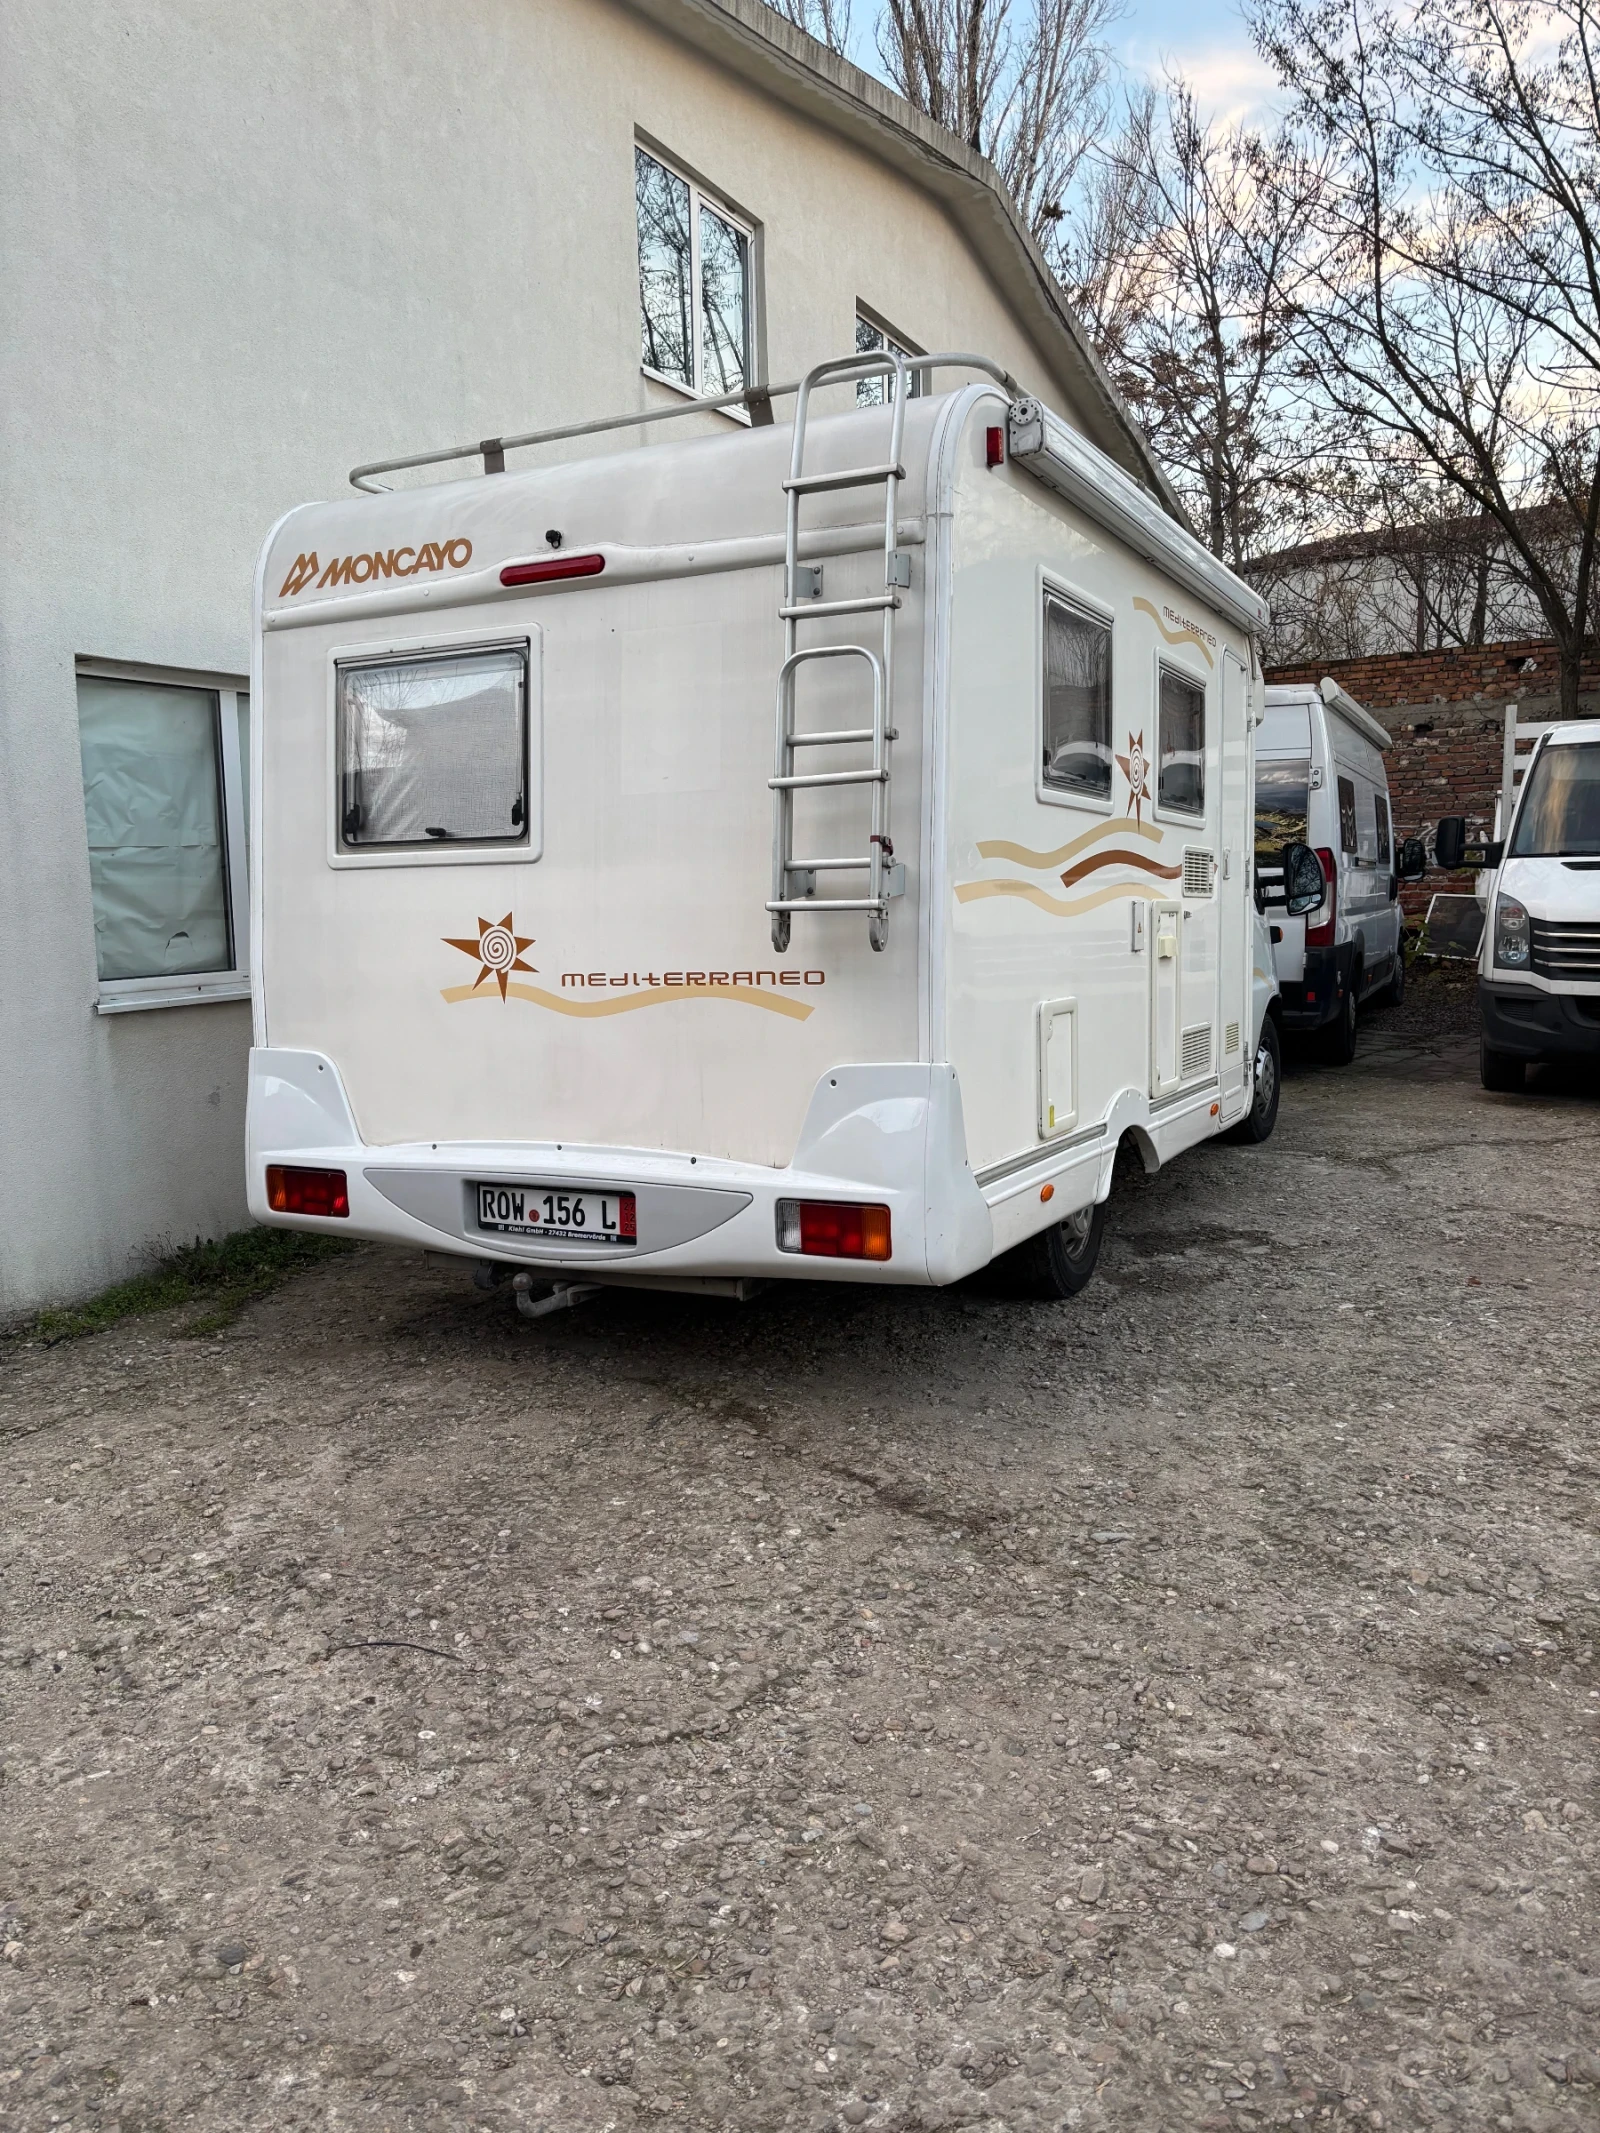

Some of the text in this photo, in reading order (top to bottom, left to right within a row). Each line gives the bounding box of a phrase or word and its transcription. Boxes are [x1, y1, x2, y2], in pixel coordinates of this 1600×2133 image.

[316, 537, 473, 589] MONCAYO
[482, 1189, 617, 1230] ROW 156 L
[548, 1229, 567, 1237] 27432
